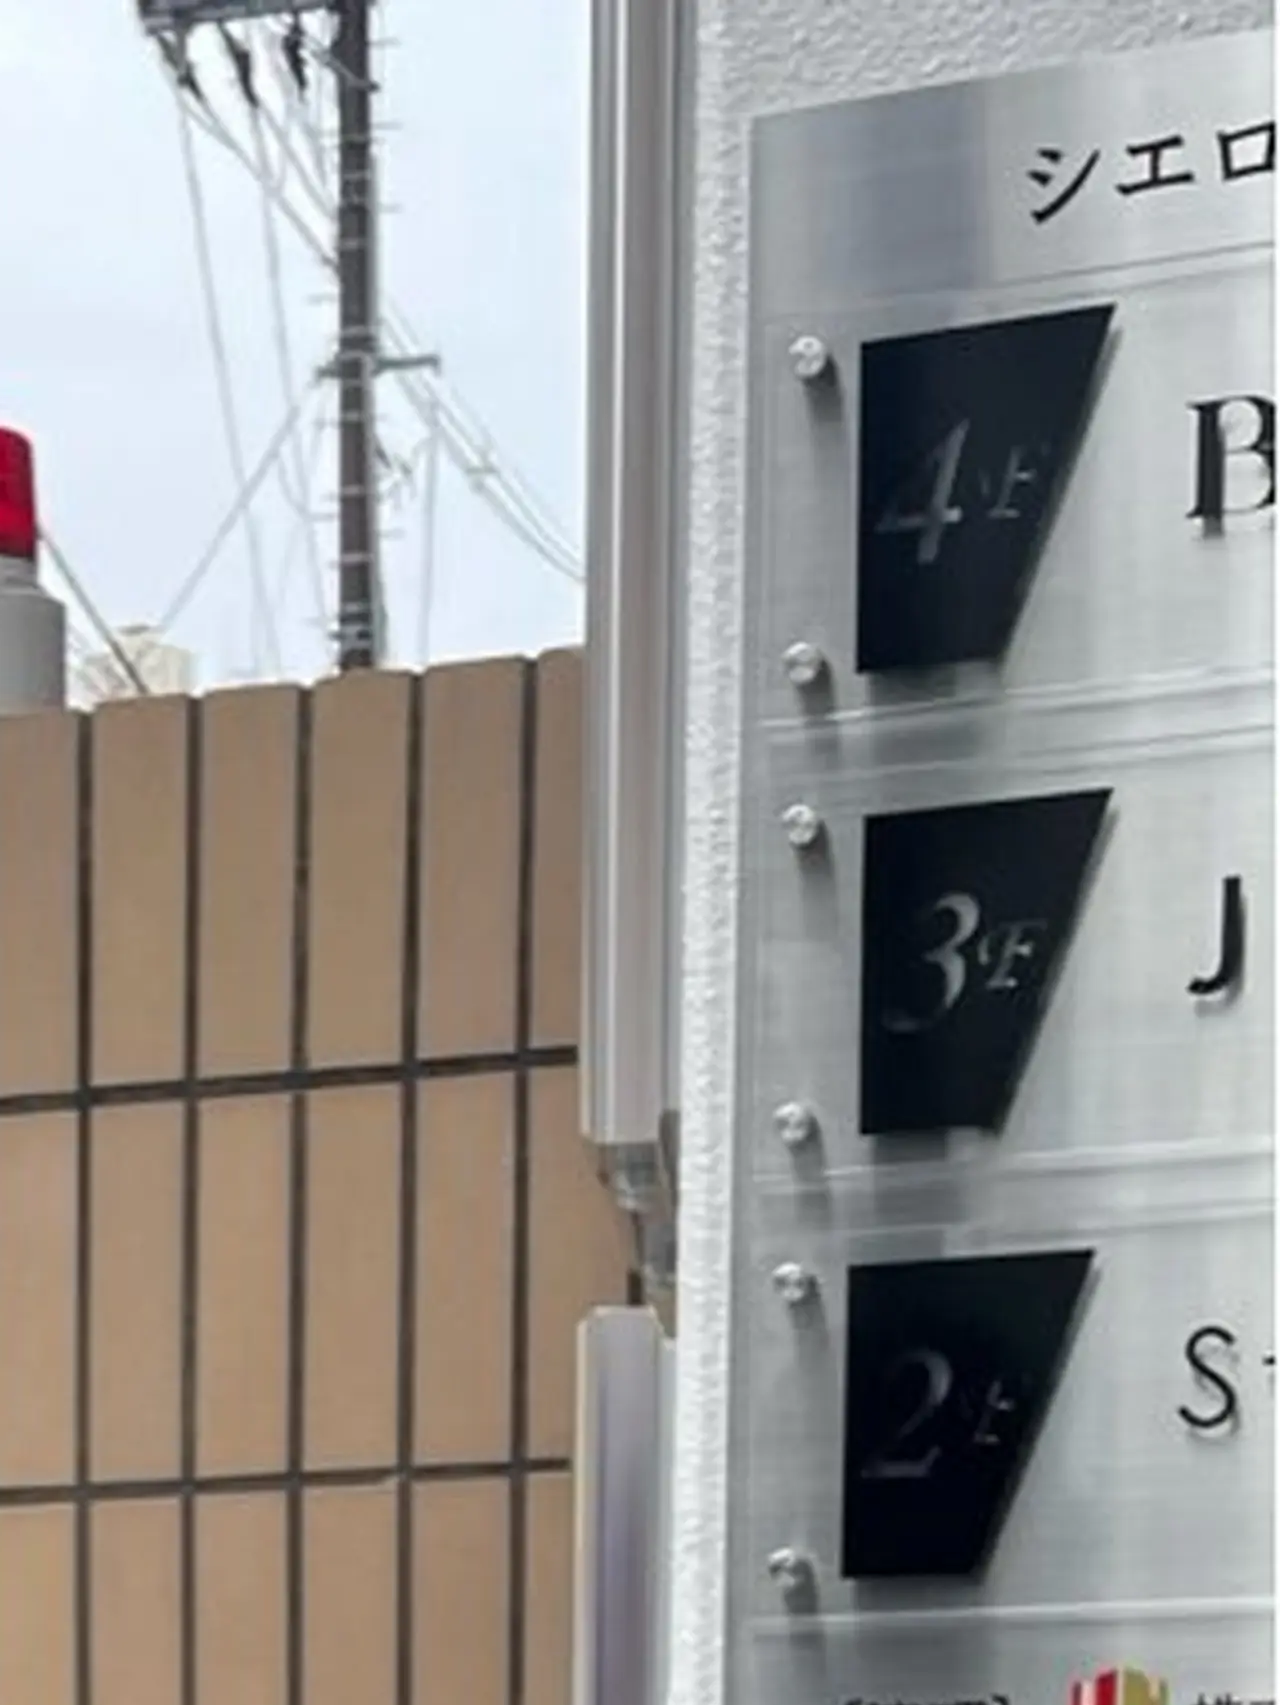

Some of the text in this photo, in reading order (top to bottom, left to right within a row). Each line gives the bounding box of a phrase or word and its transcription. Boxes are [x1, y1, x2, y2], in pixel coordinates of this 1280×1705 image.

[1026, 120, 1274, 224] シエロ
[1177, 1325, 1276, 1430] S
